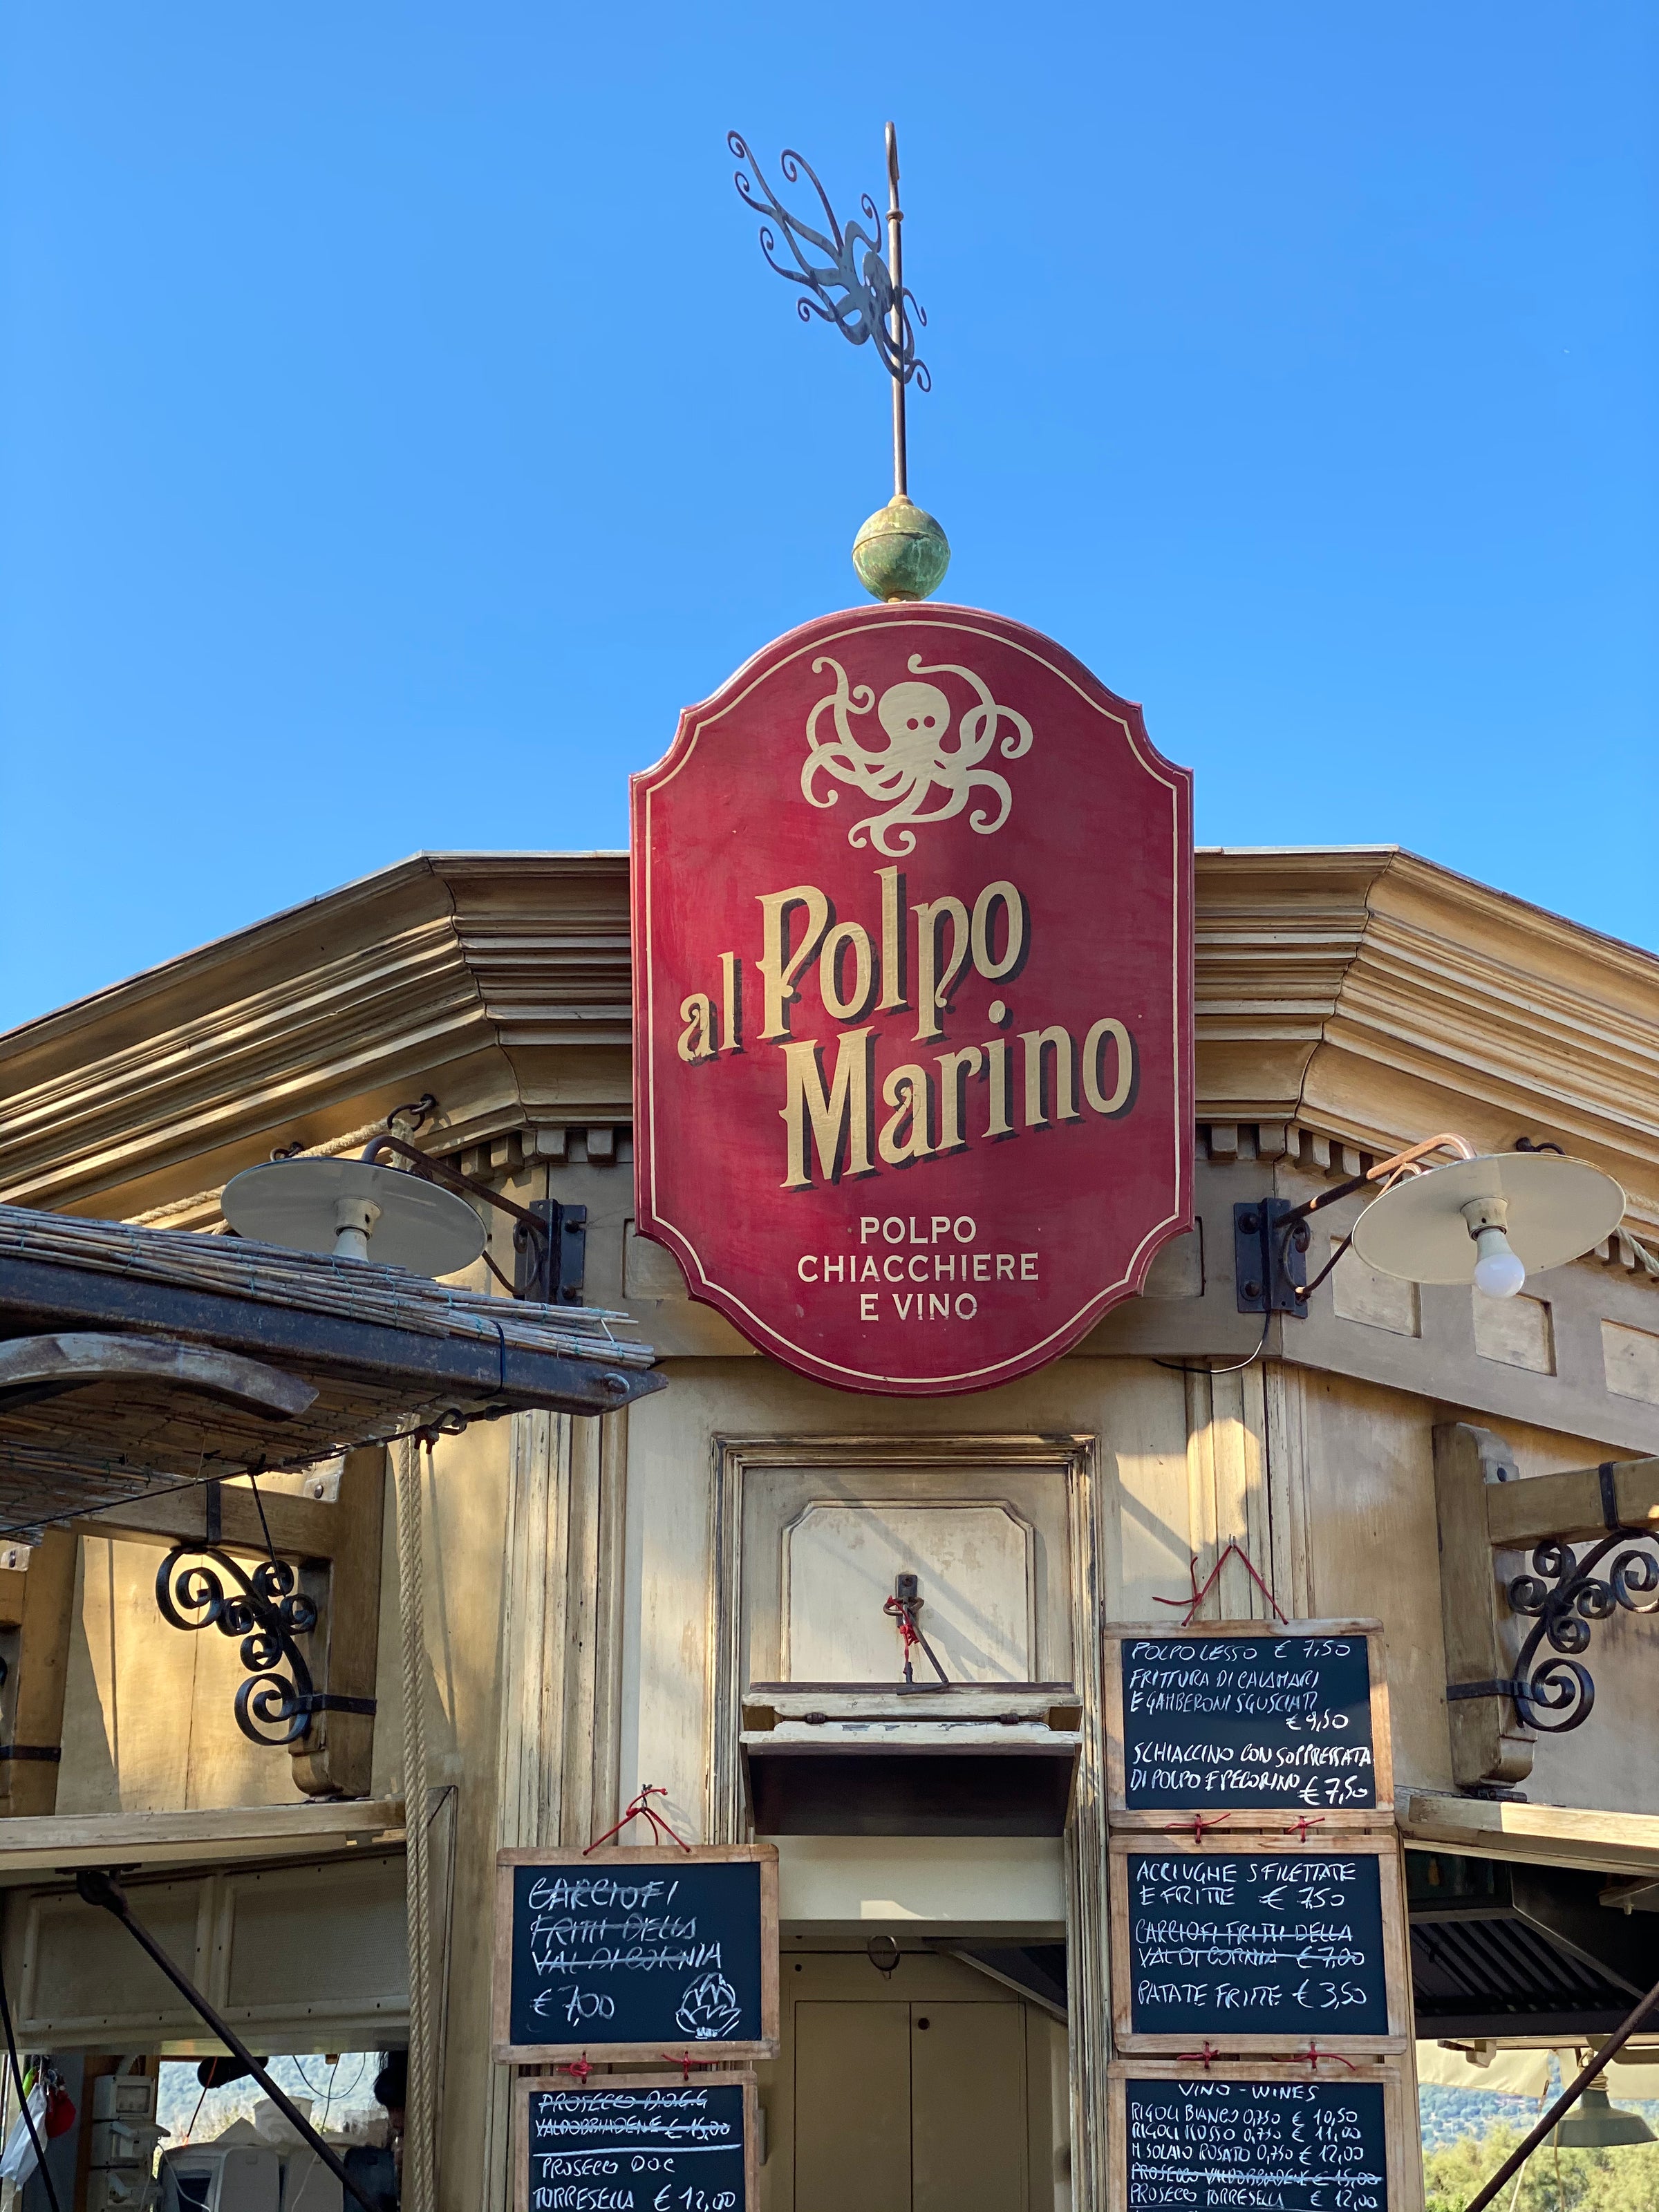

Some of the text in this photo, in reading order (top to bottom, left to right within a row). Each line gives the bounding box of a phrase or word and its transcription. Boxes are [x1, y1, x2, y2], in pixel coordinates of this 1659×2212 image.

[677, 865, 1029, 1063] al Polpo
[778, 1001, 1137, 1189] Marino
[860, 1217, 976, 1244] POLPO
[797, 1253, 1038, 1282] CHIACCHIERE
[861, 1293, 977, 1321] E VINO
[1132, 1640, 1351, 1661] POLPO LESSO € 7,50
[1130, 1669, 1320, 1689] FRITTURA DI CALAMARI
[1130, 1691, 1318, 1715] E GAMBERONI SGUSCIATI
[1286, 1709, 1349, 1732] € 9,50
[1133, 1741, 1371, 1768] SCHIACCINO CON SOPPRESSATA
[1131, 1769, 1368, 1806] DI POLPO E PECORINO € 7,50
[1136, 1860, 1356, 1882] ACCIUGHE SFILETTATE
[1140, 1886, 1344, 1910] E FRITTE € 7,50
[1136, 1918, 1353, 1945] CARCIOFI FRITTI DELLA
[532, 1950, 577, 1976] VAL
[1139, 1946, 1364, 1969] VAL DI CORNIA € 7,00
[1138, 1978, 1367, 2009] PATATE FRITTE € 3,50
[530, 1985, 615, 2027] € 7,00
[538, 2092, 635, 2113] PROSECCO
[1178, 2083, 1230, 2096] VINO
[1252, 2086, 1319, 2102] WINES
[1132, 2102, 1358, 2126] RIGOLI BIANCO 0,750 € 10,50
[665, 2118, 682, 2139] €
[686, 2117, 731, 2140] 15,00
[1132, 2123, 1361, 2143] RIGOLI ROSSO 0,750 € 11,00
[1146, 2144, 1192, 2159] SOLAIO
[1199, 2144, 1250, 2162] ROSATO
[1257, 2144, 1293, 2165] 0,750
[1299, 2146, 1312, 2165] €
[1319, 2144, 1363, 2164] 12,00
[543, 2155, 675, 2179] PROSECCO DOC
[1131, 2162, 1198, 2183] PROSECCO
[1313, 2170, 1329, 2186] €
[1335, 2168, 1382, 2187] 15,00
[533, 2184, 735, 2212] TORRESELLA € 12,00
[1131, 2182, 1378, 2209] PROSECCO TORRESELLA € 12,00
